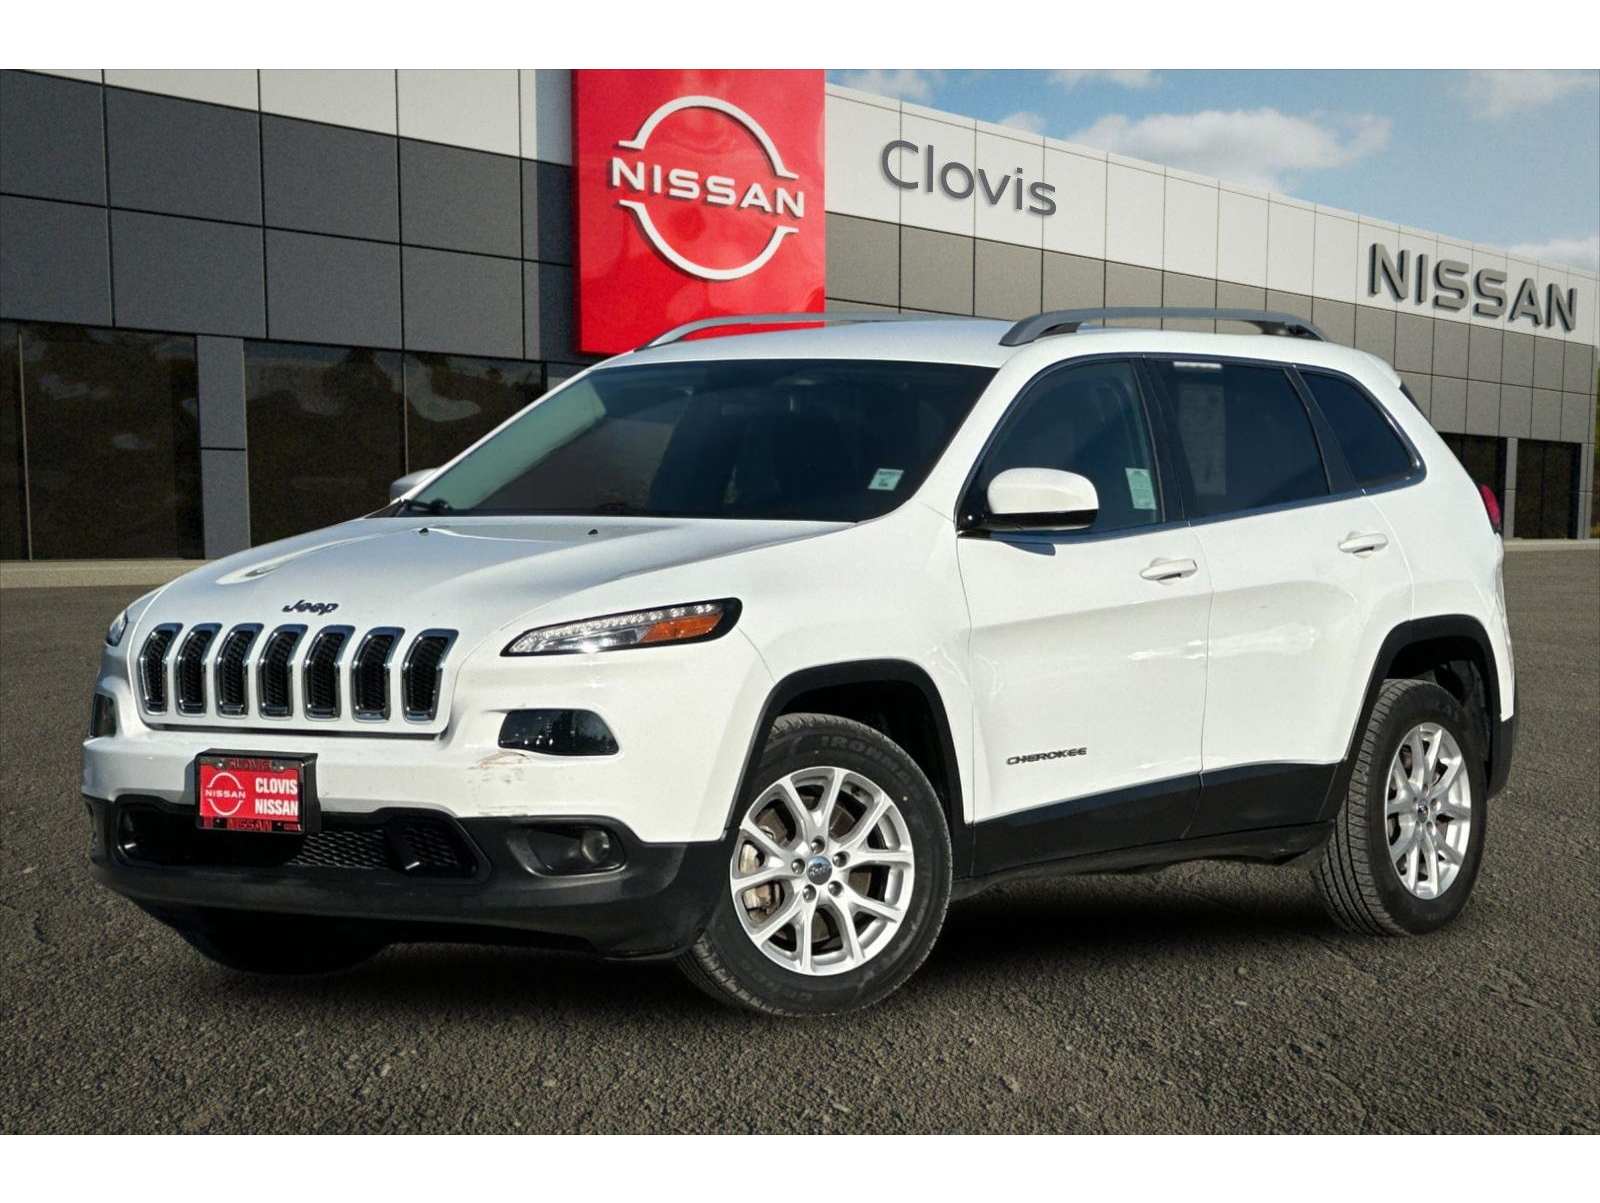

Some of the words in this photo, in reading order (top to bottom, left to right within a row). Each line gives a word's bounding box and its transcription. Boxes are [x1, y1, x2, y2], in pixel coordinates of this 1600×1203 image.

[611, 156, 805, 218] NISSAN
[881, 139, 1057, 217] Clovis
[1367, 242, 1578, 332] NISSAN
[282, 599, 339, 616] Jeep
[1006, 746, 1088, 766] CHEROKEE
[204, 788, 246, 800] NISSAN
[254, 776, 298, 796] CLOVIS
[254, 798, 299, 817] NISSAN
